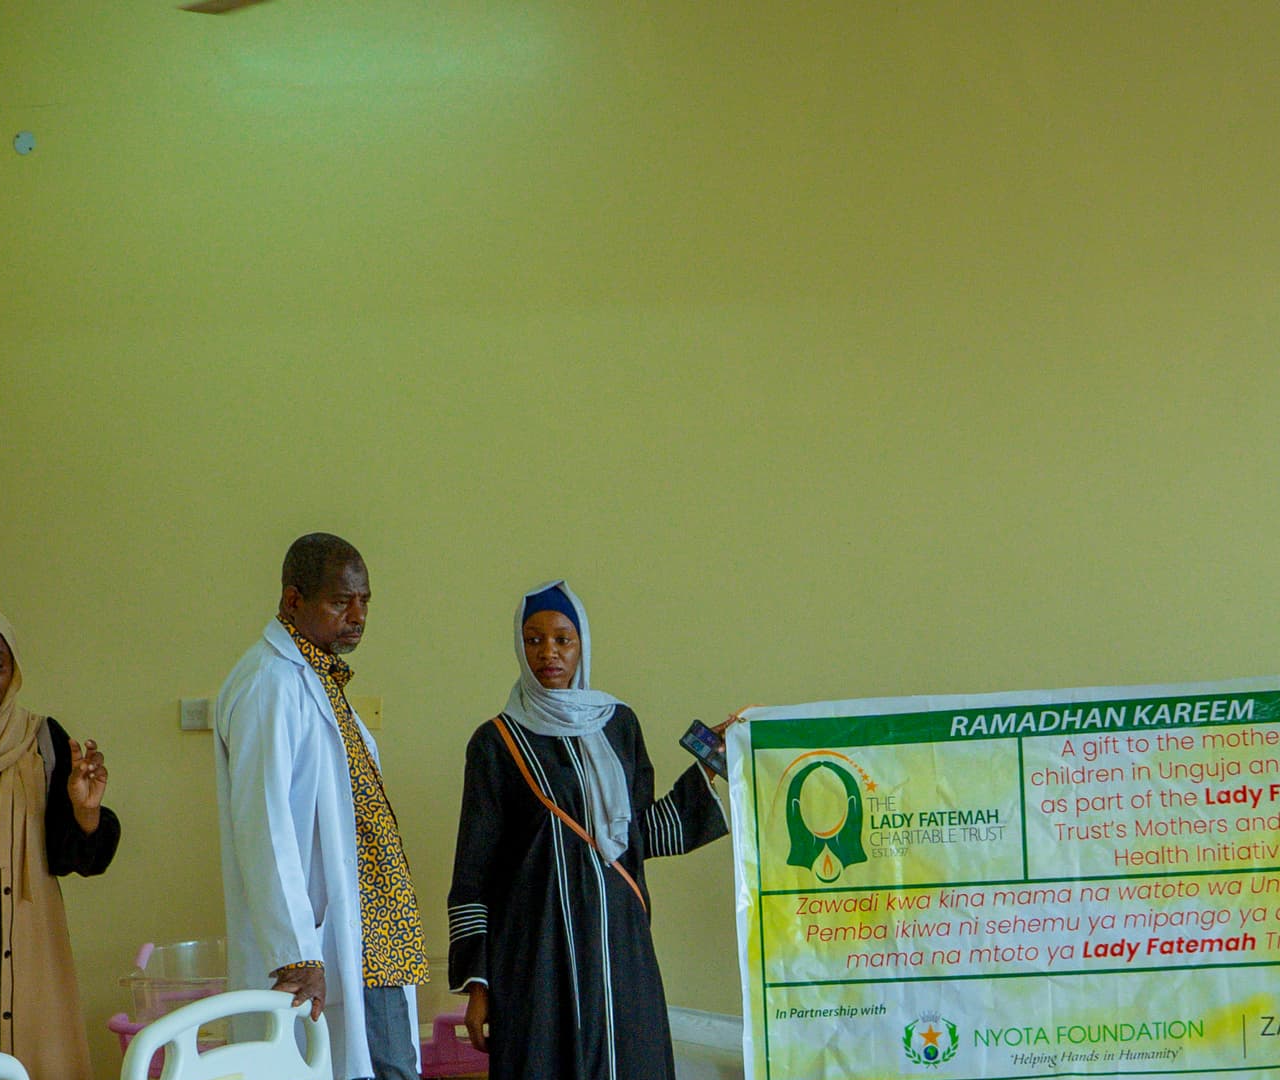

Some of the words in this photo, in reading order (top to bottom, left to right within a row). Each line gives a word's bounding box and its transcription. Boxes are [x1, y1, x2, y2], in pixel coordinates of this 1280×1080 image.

[950, 706, 1126, 736] RAMADHAN
[1132, 699, 1255, 725] KAREEM
[1061, 740, 1075, 757] A
[1083, 736, 1120, 761] gift
[1127, 737, 1149, 753] to
[1157, 733, 1194, 751] the
[1031, 766, 1124, 786] children
[1132, 763, 1151, 780] in
[1159, 758, 1241, 783] Unguja
[866, 796, 896, 812] THE
[1041, 798, 1068, 814] as
[1076, 793, 1122, 817] part
[1130, 790, 1153, 809] of
[1160, 789, 1198, 807] the
[1205, 784, 1263, 809] Lady
[871, 813, 914, 829] LADY
[919, 809, 999, 827] FATEMAH
[1054, 820, 1127, 841] Trust's
[1135, 816, 1228, 837] Mothers
[1235, 811, 1280, 832] and
[869, 828, 957, 847] CHARITABLE
[961, 826, 1006, 842] TRUST
[1114, 845, 1188, 866] Health
[796, 893, 878, 916] Zawadi
[886, 892, 931, 911] kwa
[939, 885, 985, 907] kina
[992, 887, 1072, 905] mama
[1080, 886, 1110, 902] na
[1118, 879, 1200, 900] watoto
[1208, 879, 1243, 896] wa
[806, 922, 888, 943] Pemba
[894, 917, 950, 939] ikiwa
[958, 917, 979, 936] ni
[985, 910, 1080, 935] sehemu
[1087, 913, 1115, 934] ya
[1123, 907, 1231, 931] mipango
[1239, 905, 1267, 927] ya
[846, 949, 923, 968] mama
[931, 947, 961, 964] na
[968, 943, 1039, 964] mtoto
[1046, 945, 1074, 967] ya
[1082, 937, 1141, 962] Lady
[1146, 932, 1257, 955] Fatemah
[775, 1008, 787, 1020] In
[790, 1005, 858, 1019] Partnership
[860, 1004, 886, 1016] with
[974, 1026, 1050, 1047] NYOTA
[1057, 1019, 1204, 1044] FOUNDATION
[1060, 1050, 1099, 1062] Hands
[1103, 1049, 1115, 1061] in
